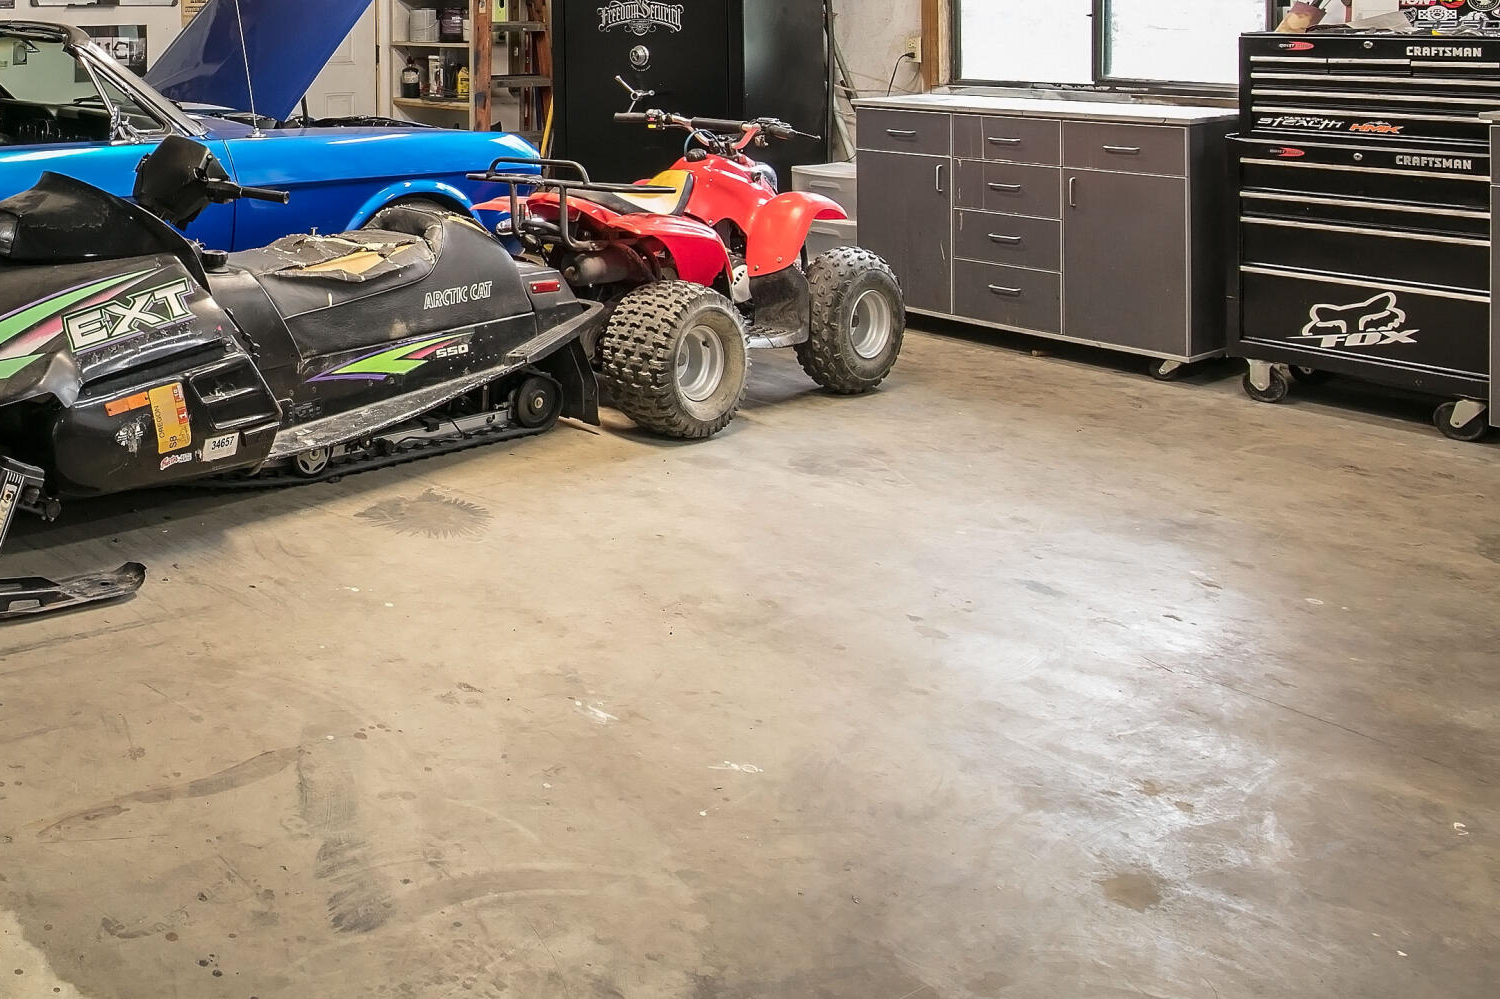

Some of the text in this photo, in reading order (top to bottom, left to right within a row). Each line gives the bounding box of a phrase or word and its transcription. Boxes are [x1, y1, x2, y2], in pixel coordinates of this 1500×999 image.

[597, 0, 685, 32] Freedom Security
[1406, 46, 1483, 58] CRAFTSMAN
[1395, 155, 1472, 170] CRAFTSMAN
[423, 280, 493, 310] ARCTIC CAT
[63, 278, 193, 352] EXT
[1286, 328, 1421, 348] FOX
[435, 343, 469, 359] 550
[153, 405, 165, 439] OREGON
[211, 436, 235, 450] 34657
